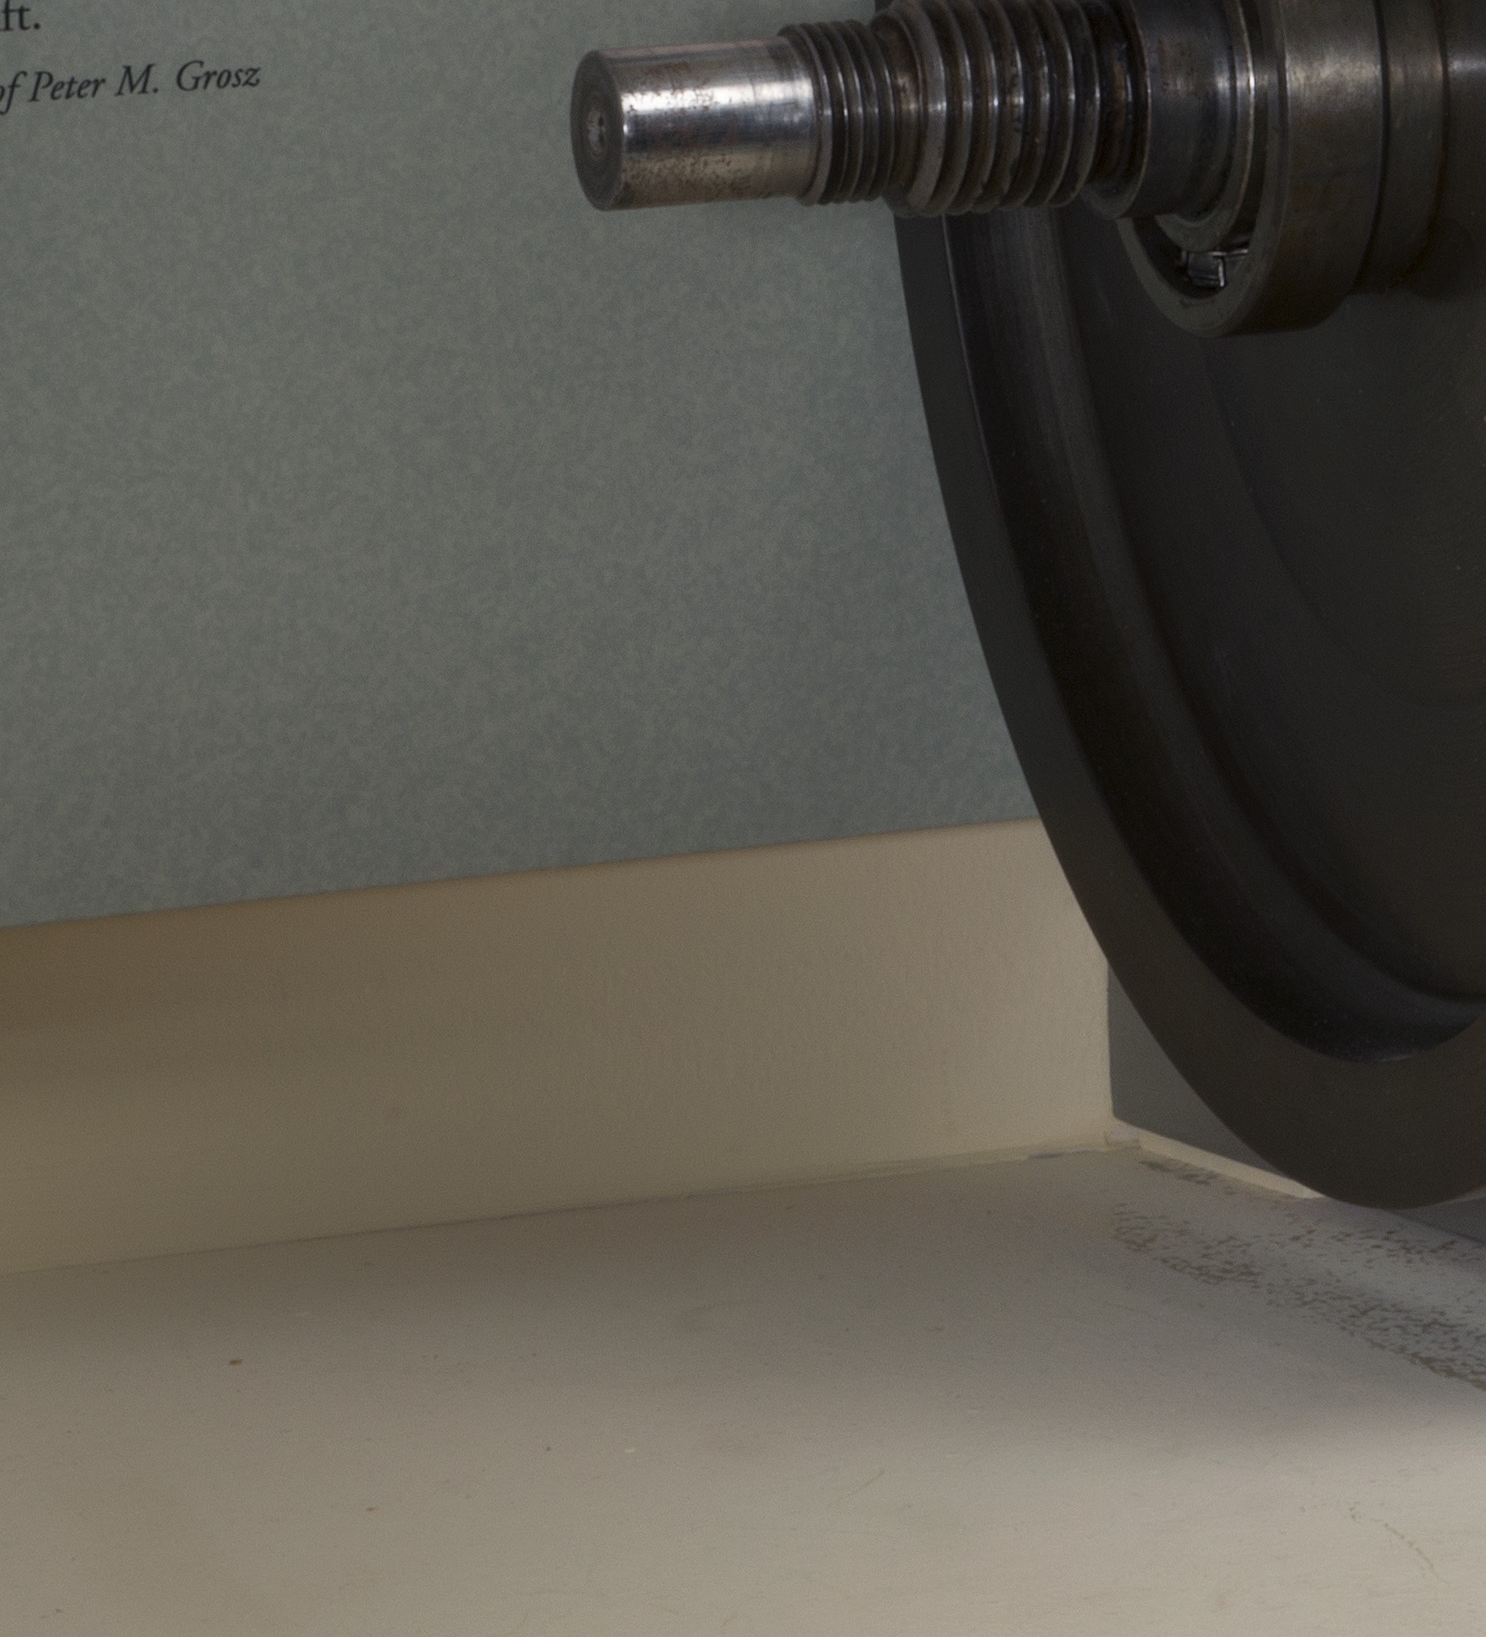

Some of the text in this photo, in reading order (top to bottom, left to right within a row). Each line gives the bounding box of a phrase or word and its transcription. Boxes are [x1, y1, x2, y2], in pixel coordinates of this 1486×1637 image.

[28, 71, 106, 102] Peter
[115, 64, 158, 96] M.
[176, 60, 260, 91] Grosz
